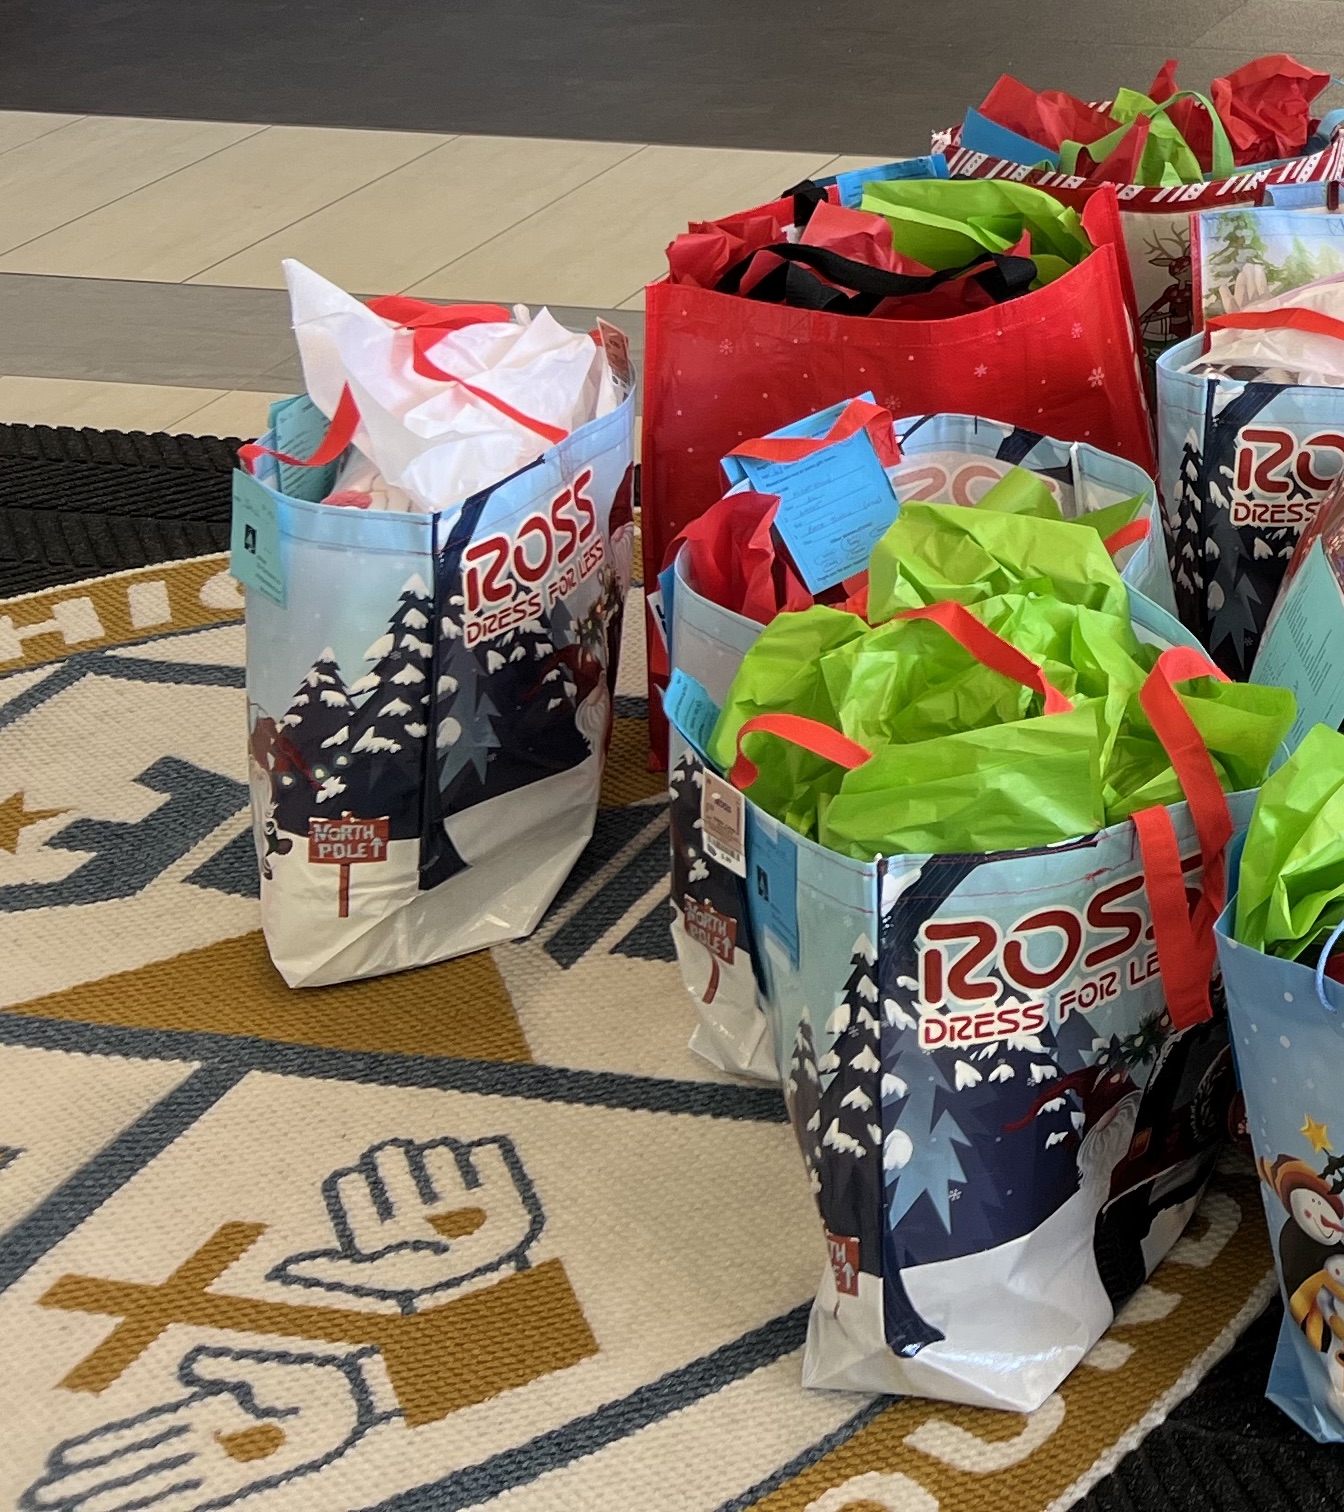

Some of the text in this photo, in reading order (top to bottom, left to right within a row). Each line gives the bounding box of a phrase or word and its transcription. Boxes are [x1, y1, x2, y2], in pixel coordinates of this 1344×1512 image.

[465, 468, 597, 613] ROSS
[466, 537, 605, 645] DRESS FOR LESS
[313, 822, 376, 844] NORTH
[318, 840, 367, 860] POLE
[924, 854, 1204, 1004] ROS
[924, 951, 1161, 1044] DRESS FOR LE
